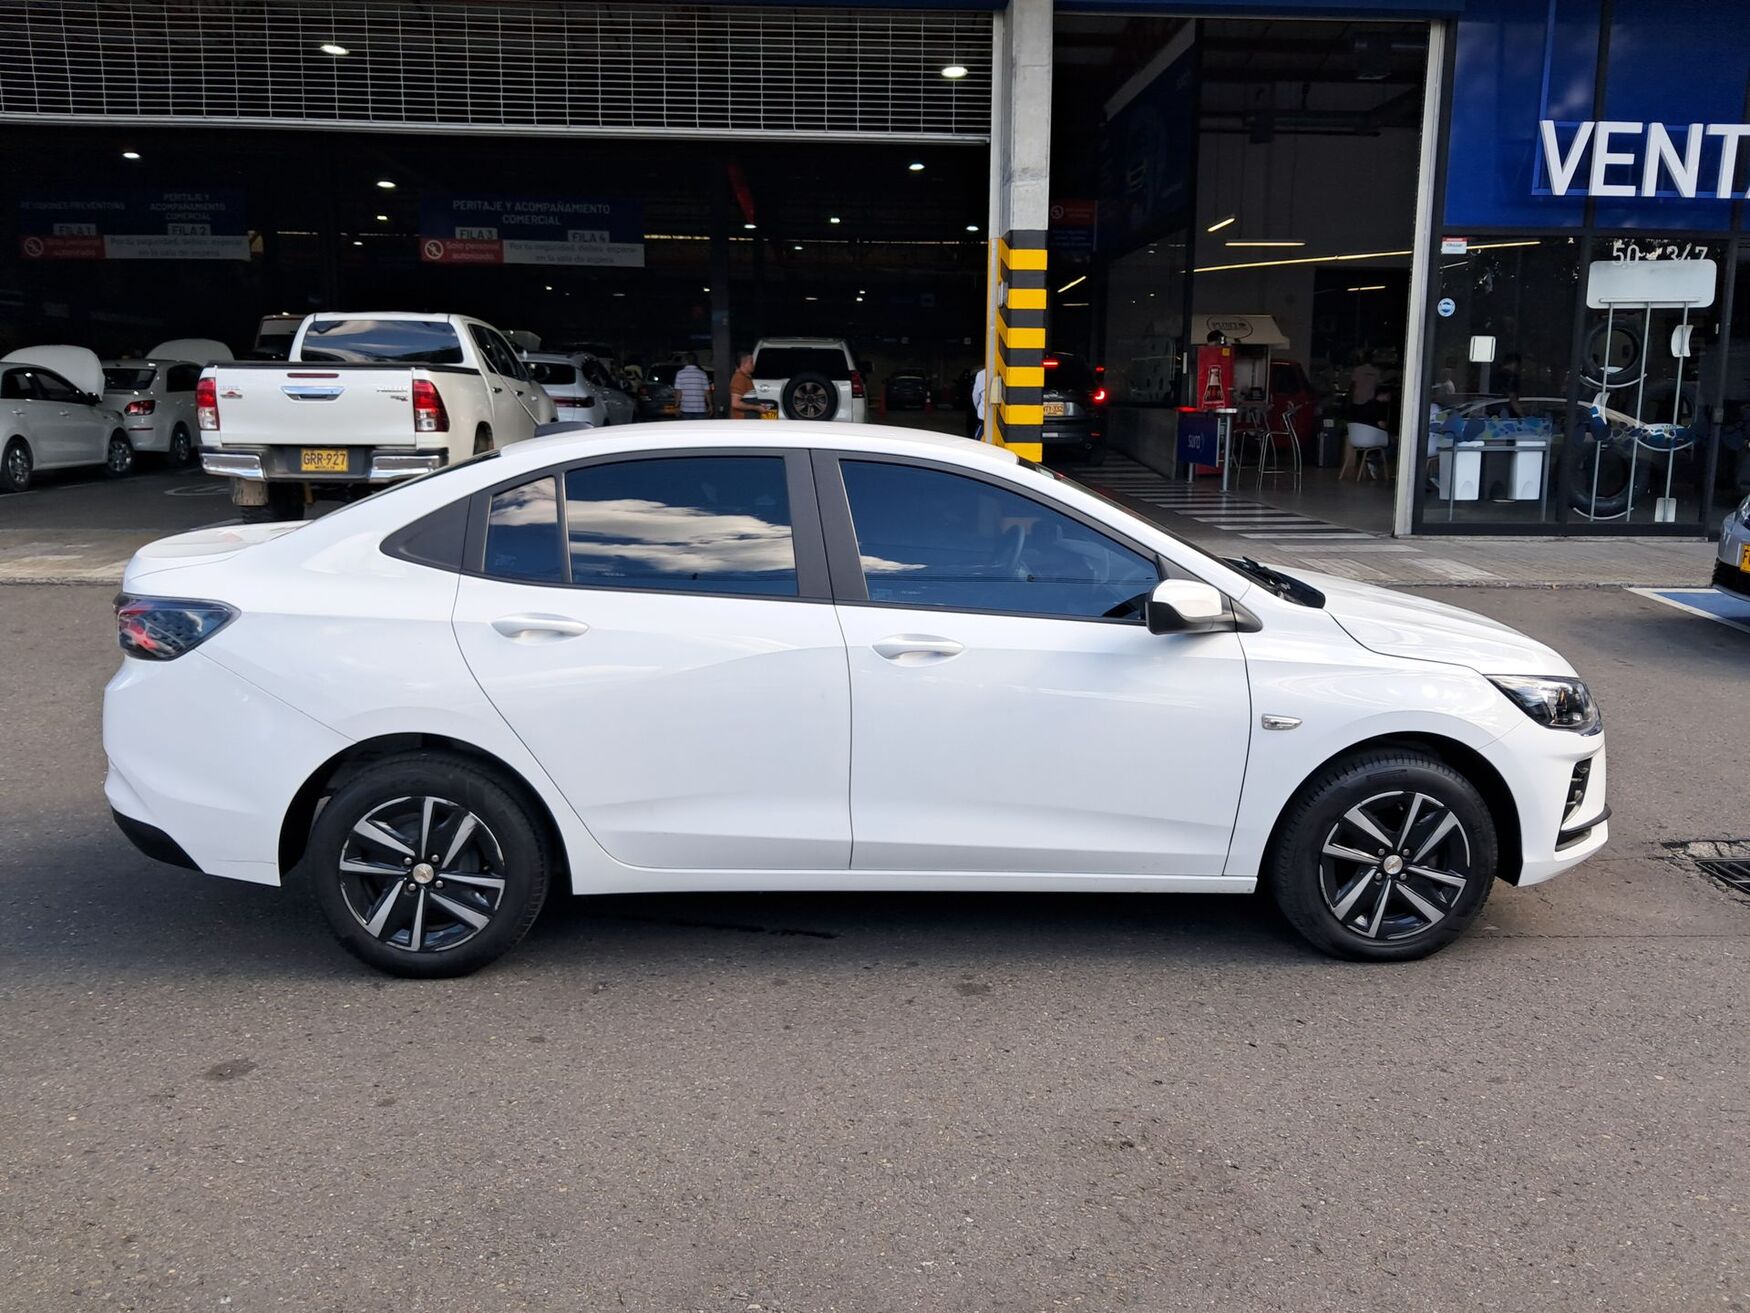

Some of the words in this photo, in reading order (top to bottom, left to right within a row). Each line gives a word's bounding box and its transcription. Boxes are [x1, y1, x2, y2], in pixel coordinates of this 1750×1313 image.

[1539, 120, 1750, 199] VENT
[452, 200, 503, 212] PERITAJE
[504, 201, 512, 212] Y
[514, 200, 610, 214] ACOMPAÑAMIENTO
[502, 214, 561, 225] COMERCIAL
[172, 226, 197, 235] FILA
[199, 226, 207, 235] 2
[460, 230, 484, 240] FILA
[485, 230, 494, 240] 3
[572, 233, 595, 243] FILA
[597, 233, 605, 243] 4
[303, 453, 346, 466] GRR-927
